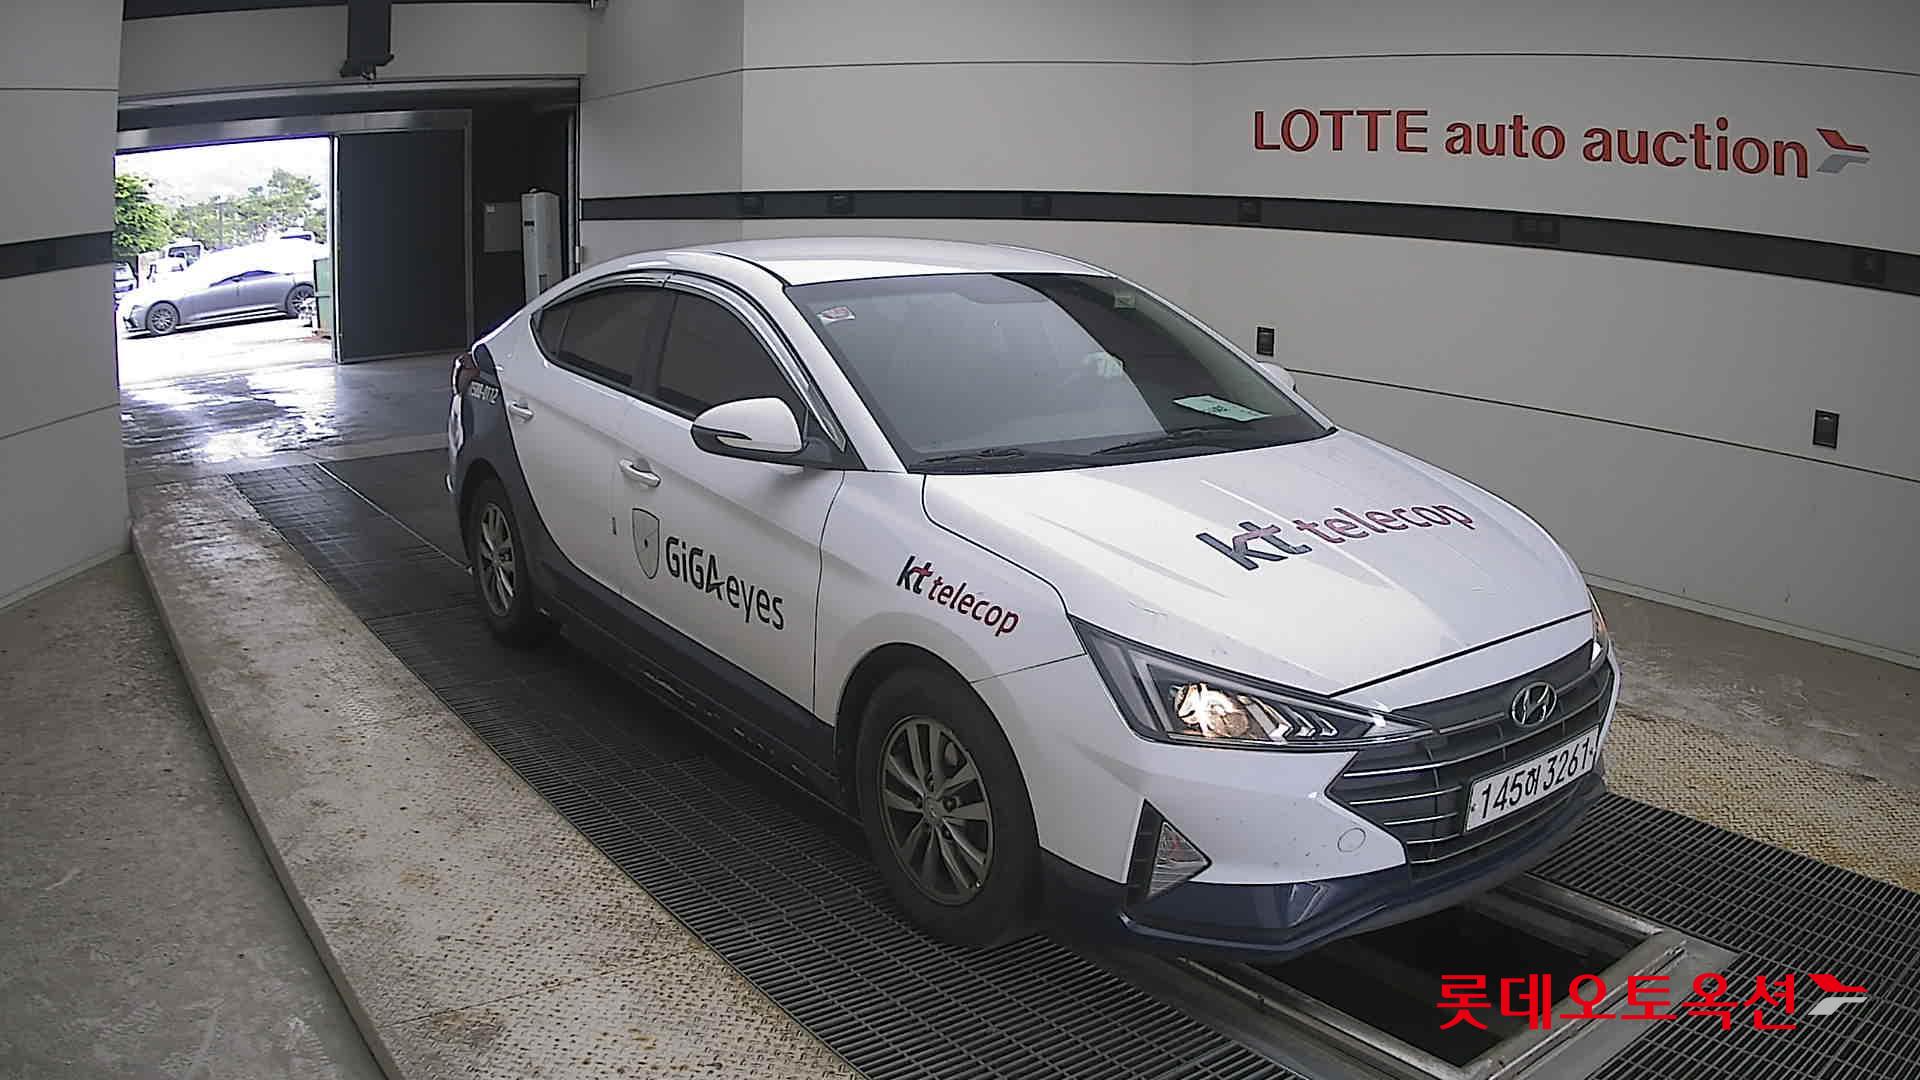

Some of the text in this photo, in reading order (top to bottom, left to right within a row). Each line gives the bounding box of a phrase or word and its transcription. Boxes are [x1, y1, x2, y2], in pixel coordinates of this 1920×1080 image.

[1254, 109, 1809, 179] LOTTE auto auction
[1195, 504, 1477, 572] kt telecop
[896, 554, 1020, 637] kt telecop
